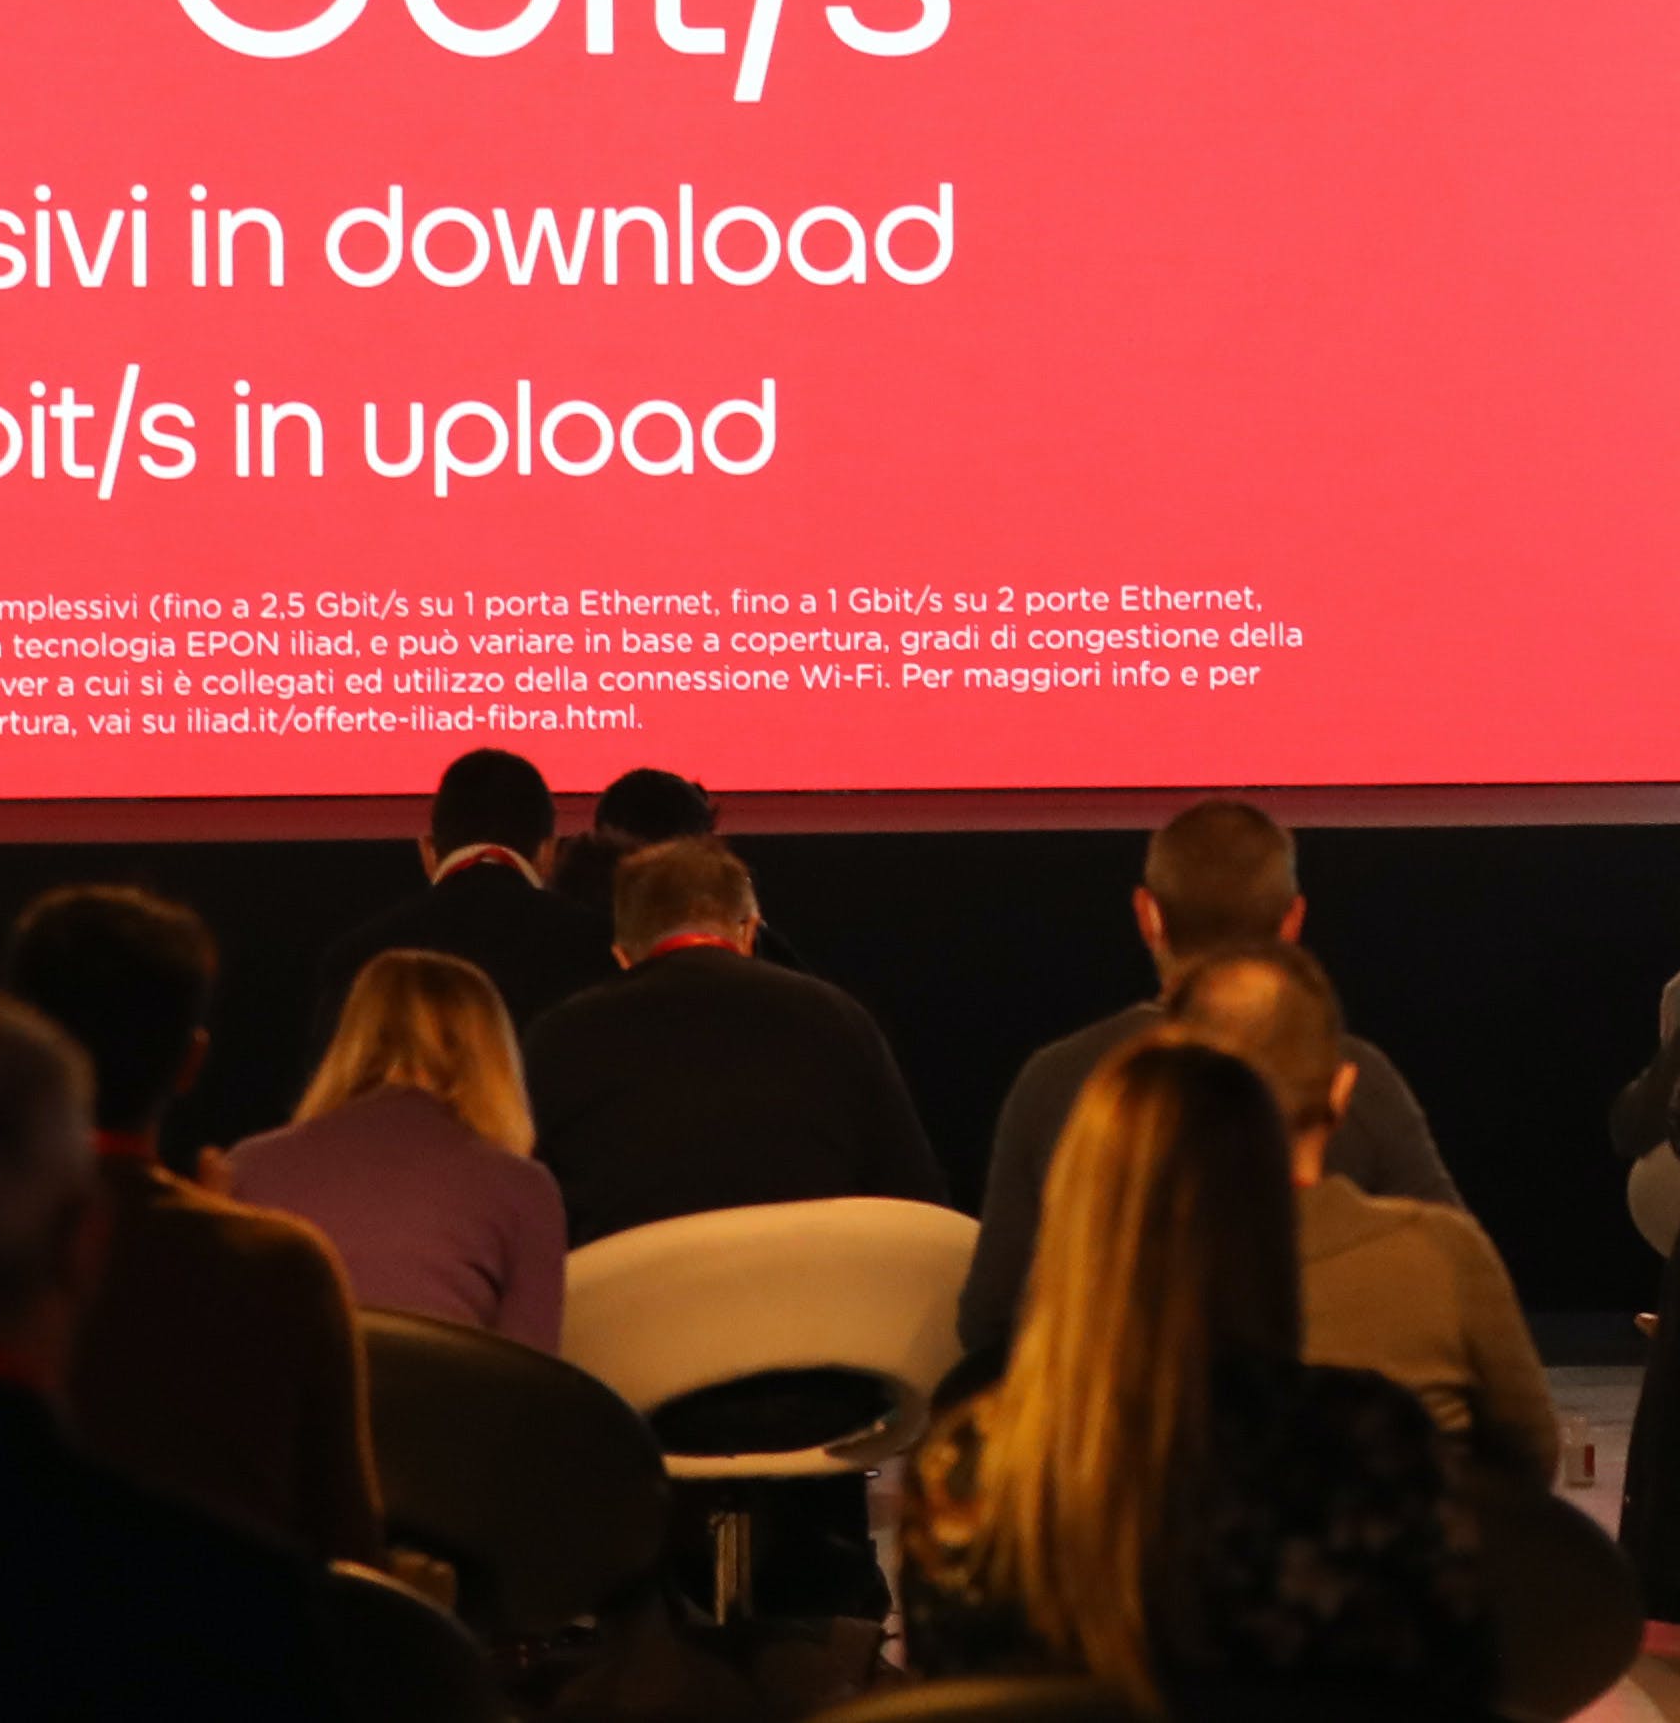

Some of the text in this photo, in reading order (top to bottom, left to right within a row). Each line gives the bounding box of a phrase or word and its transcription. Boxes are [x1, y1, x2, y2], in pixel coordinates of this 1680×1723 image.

[189, 183, 285, 288] in
[325, 182, 954, 288] download
[233, 379, 324, 478] in
[363, 377, 777, 498] upload
[149, 592, 222, 623] (fino
[231, 598, 250, 620] a
[259, 591, 306, 621] 2,5
[315, 588, 410, 621] Gbit/s
[419, 596, 454, 618] su
[463, 590, 474, 616] 1
[485, 591, 569, 621] porta
[579, 588, 721, 617] Ethernet,
[730, 587, 790, 615] fino
[799, 593, 817, 615] a
[827, 587, 837, 614] 1
[848, 584, 943, 616] Gbit/s
[953, 592, 988, 613] su
[996, 585, 1015, 613] 2
[1025, 586, 1110, 617] porte
[1120, 584, 1263, 612] Ethernet,
[12, 631, 176, 663] tecnologia
[186, 630, 280, 658] EPON
[290, 629, 361, 658] iliad,
[369, 635, 389, 656] e
[398, 628, 459, 660] può
[468, 627, 575, 655] variare
[585, 627, 611, 654] in
[621, 627, 694, 654] base
[702, 632, 720, 653] a
[730, 627, 890, 657] copertura,
[899, 624, 980, 656] gradi
[989, 623, 1017, 650] di
[1027, 622, 1220, 655] congestione
[1229, 621, 1303, 648] della
[56, 675, 75, 697] a
[84, 669, 130, 697] cui
[140, 669, 163, 697] si
[173, 668, 192, 696] è
[201, 668, 335, 700] collegati
[344, 667, 383, 695] ed
[393, 666, 505, 694] utilizzo
[514, 665, 588, 693] della
[598, 664, 790, 692] connessione
[799, 663, 891, 690] Wi-Fi.
[901, 662, 954, 689] Per
[963, 661, 1101, 693] maggiori
[1112, 659, 1171, 687] info
[1179, 665, 1199, 687] e
[1209, 665, 1262, 691] per
[87, 707, 131, 735] vai
[141, 713, 176, 735] su
[187, 703, 643, 736] iliad.it/offerte-iliad-fibra.html.
